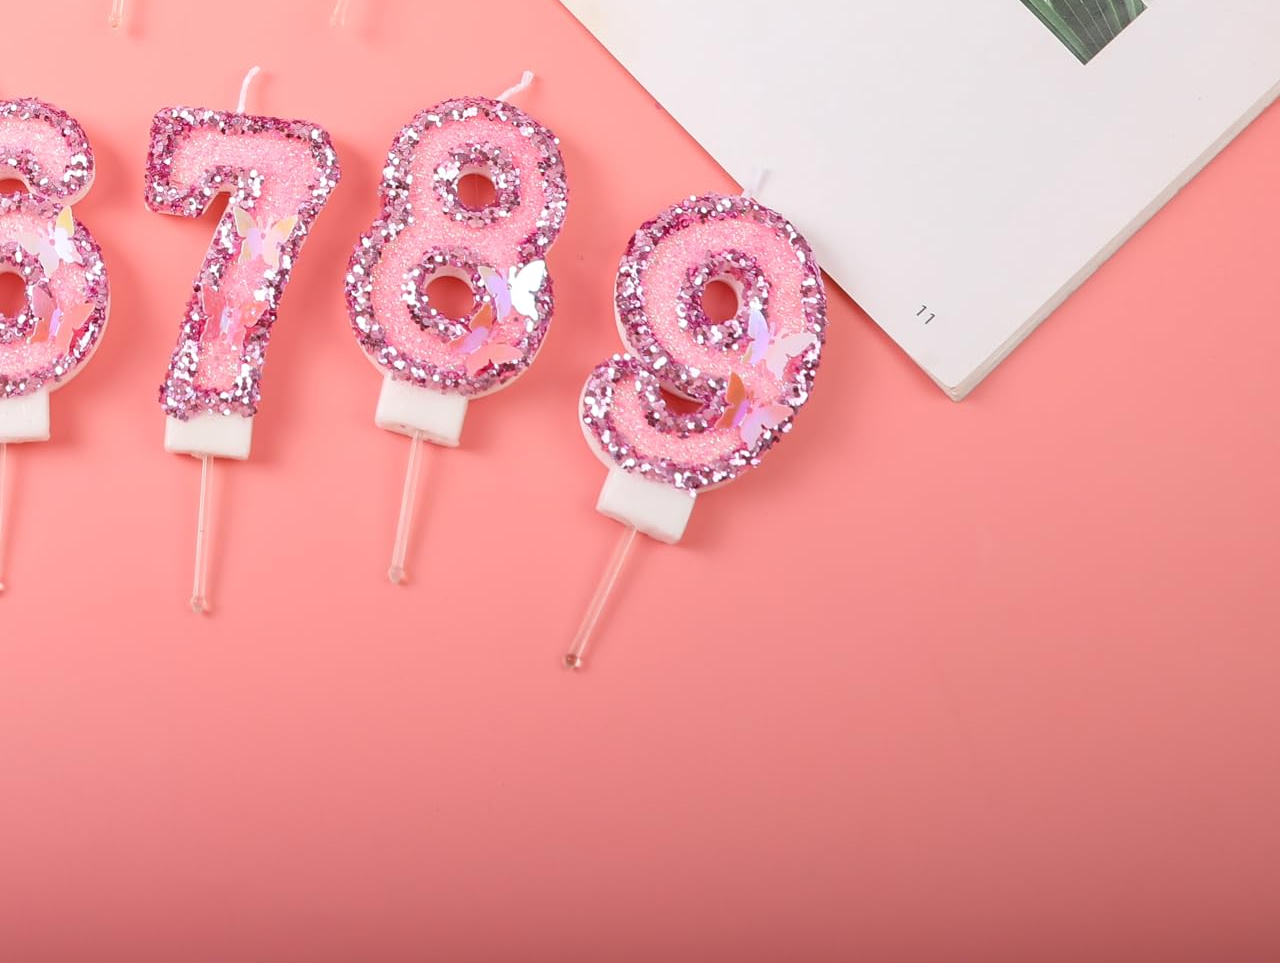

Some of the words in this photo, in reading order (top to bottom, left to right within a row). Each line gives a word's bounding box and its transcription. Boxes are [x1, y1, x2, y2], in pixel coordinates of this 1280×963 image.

[145, 106, 342, 421] 7
[344, 96, 569, 399] 8
[578, 192, 828, 497] 9
[916, 304, 936, 325] 11
